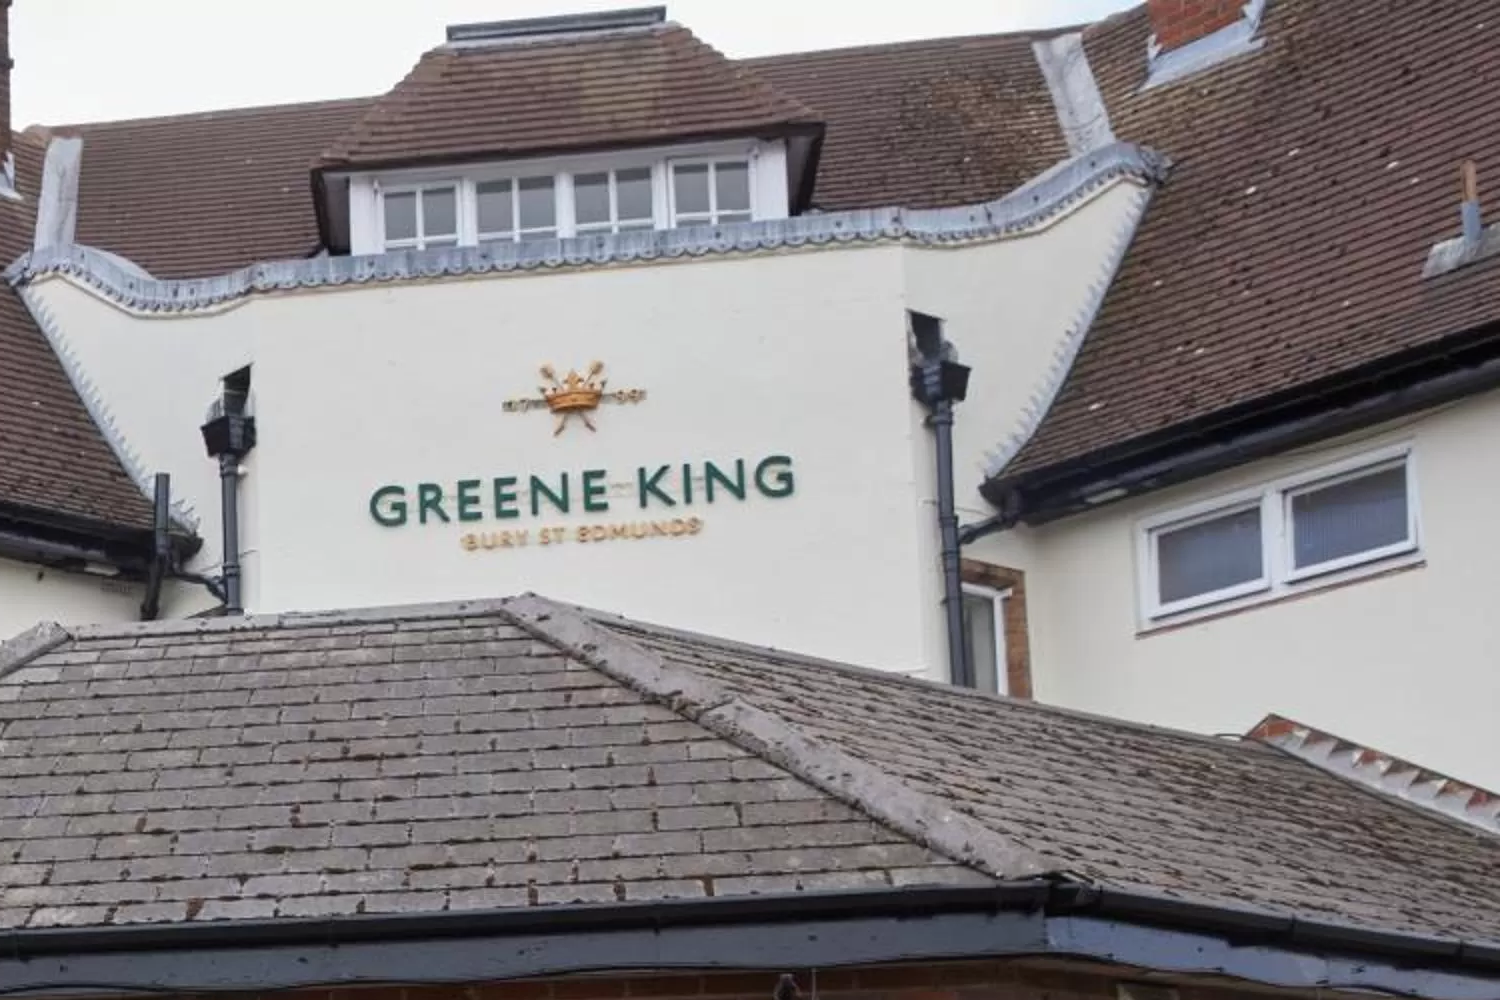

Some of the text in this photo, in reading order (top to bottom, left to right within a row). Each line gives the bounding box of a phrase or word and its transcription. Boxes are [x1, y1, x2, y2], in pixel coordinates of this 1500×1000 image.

[369, 455, 796, 528] GREENE KING
[461, 516, 705, 551] BURY ST EDMUNDS
